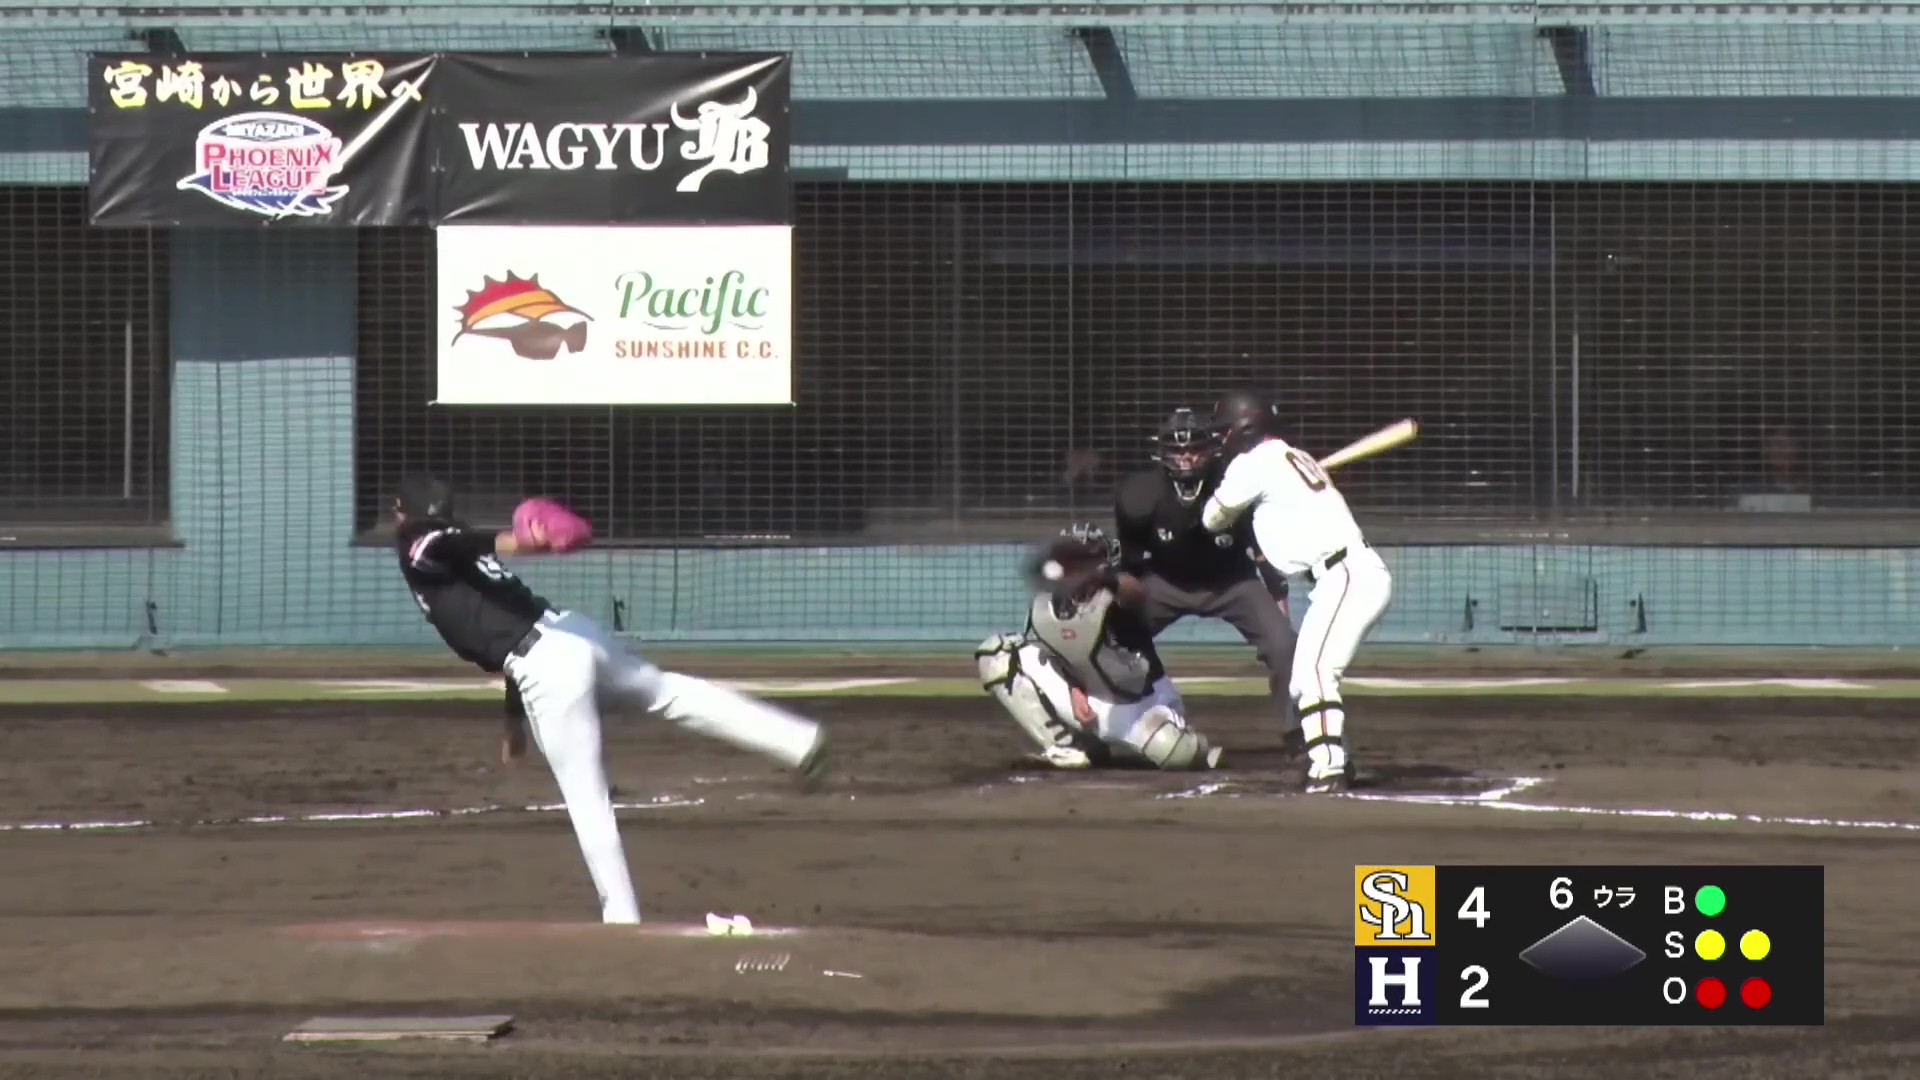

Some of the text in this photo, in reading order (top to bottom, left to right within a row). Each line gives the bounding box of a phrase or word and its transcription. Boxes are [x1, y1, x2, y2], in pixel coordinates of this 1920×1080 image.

[103, 59, 423, 109] 宮崎から世界へ
[203, 143, 332, 169] PHOENIX
[458, 122, 670, 170] WAGYU
[615, 270, 770, 334] Pacific
[614, 340, 779, 360] SUNSHINE C.C.
